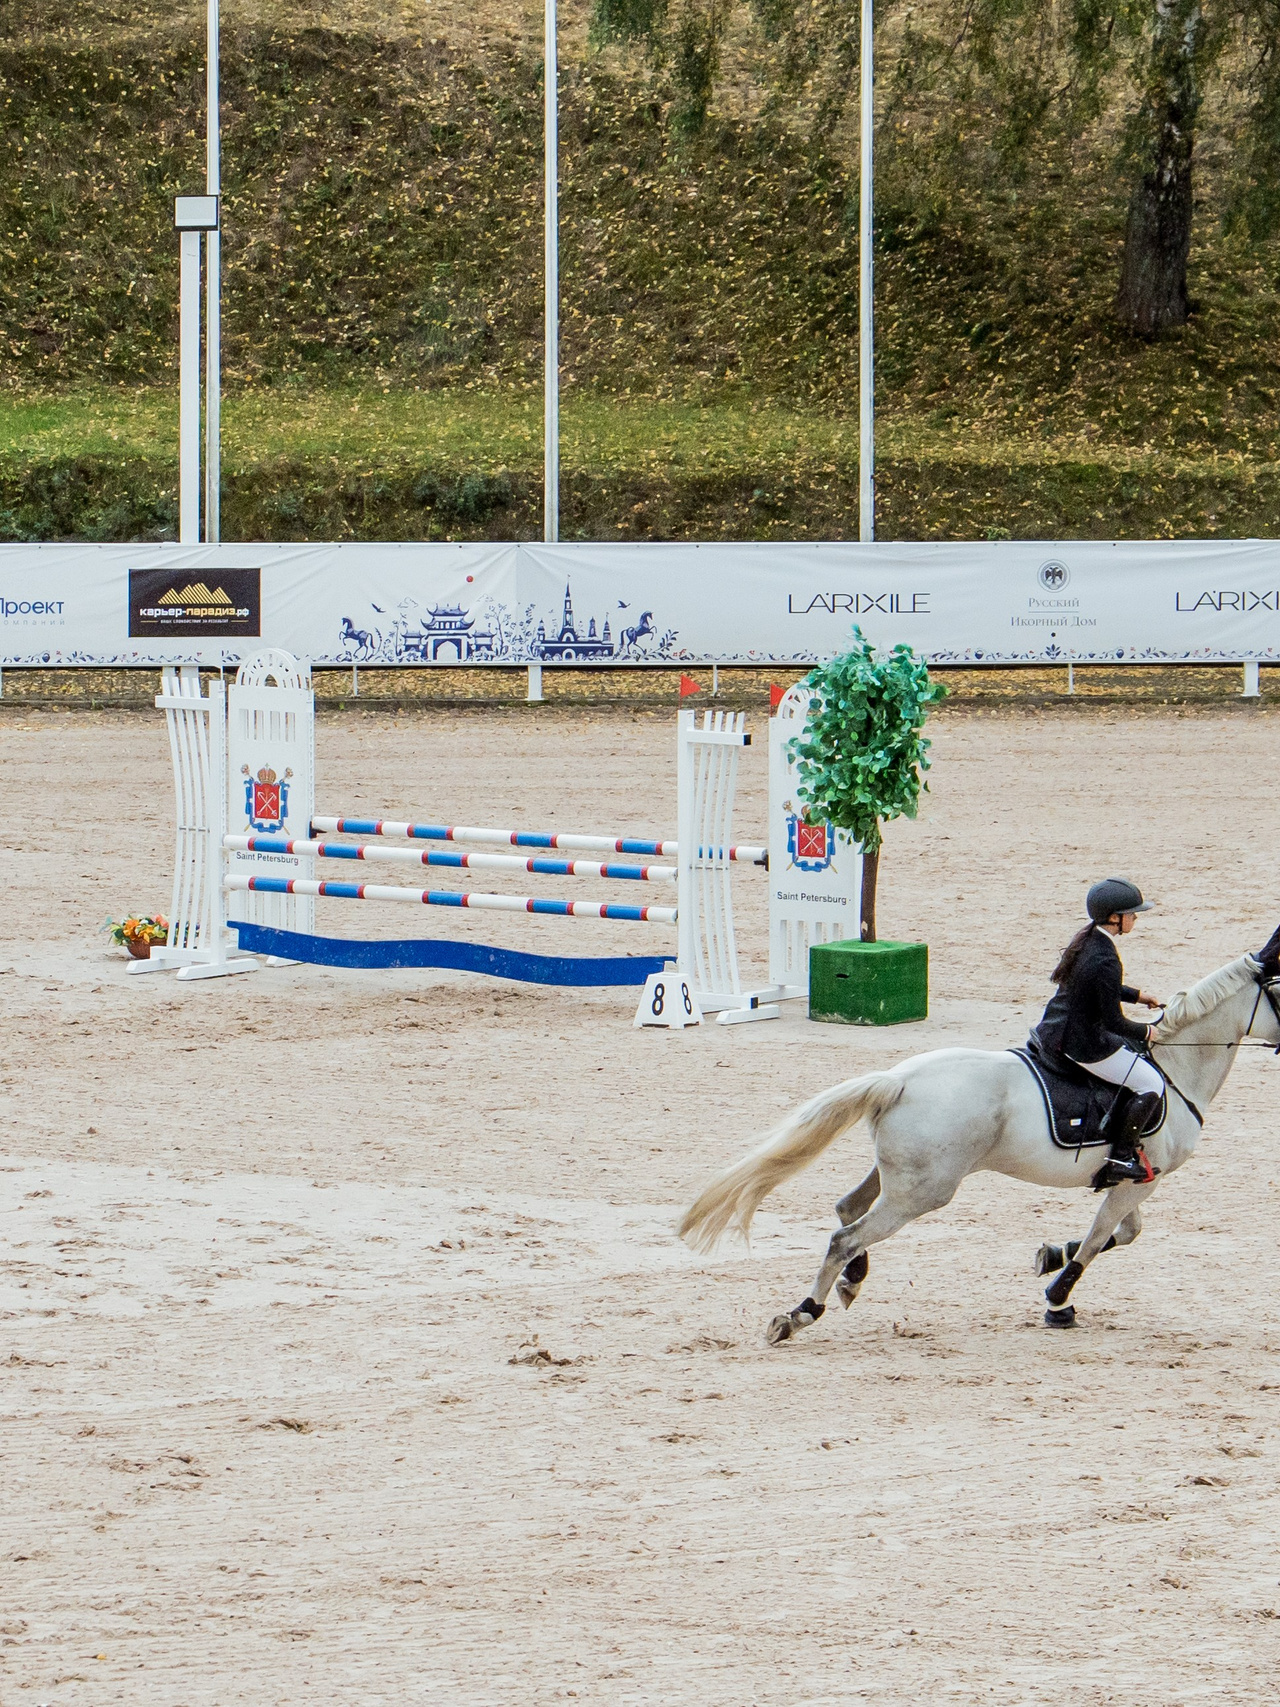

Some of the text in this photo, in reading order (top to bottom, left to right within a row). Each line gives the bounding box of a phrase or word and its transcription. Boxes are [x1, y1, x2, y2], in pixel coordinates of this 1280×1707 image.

[3, 618, 65, 626] омпаний
[236, 851, 299, 866] Saint Petersburg
[777, 891, 847, 905] Saint Petersburg
[652, 983, 665, 1016] 8
[682, 982, 692, 1015] 8
